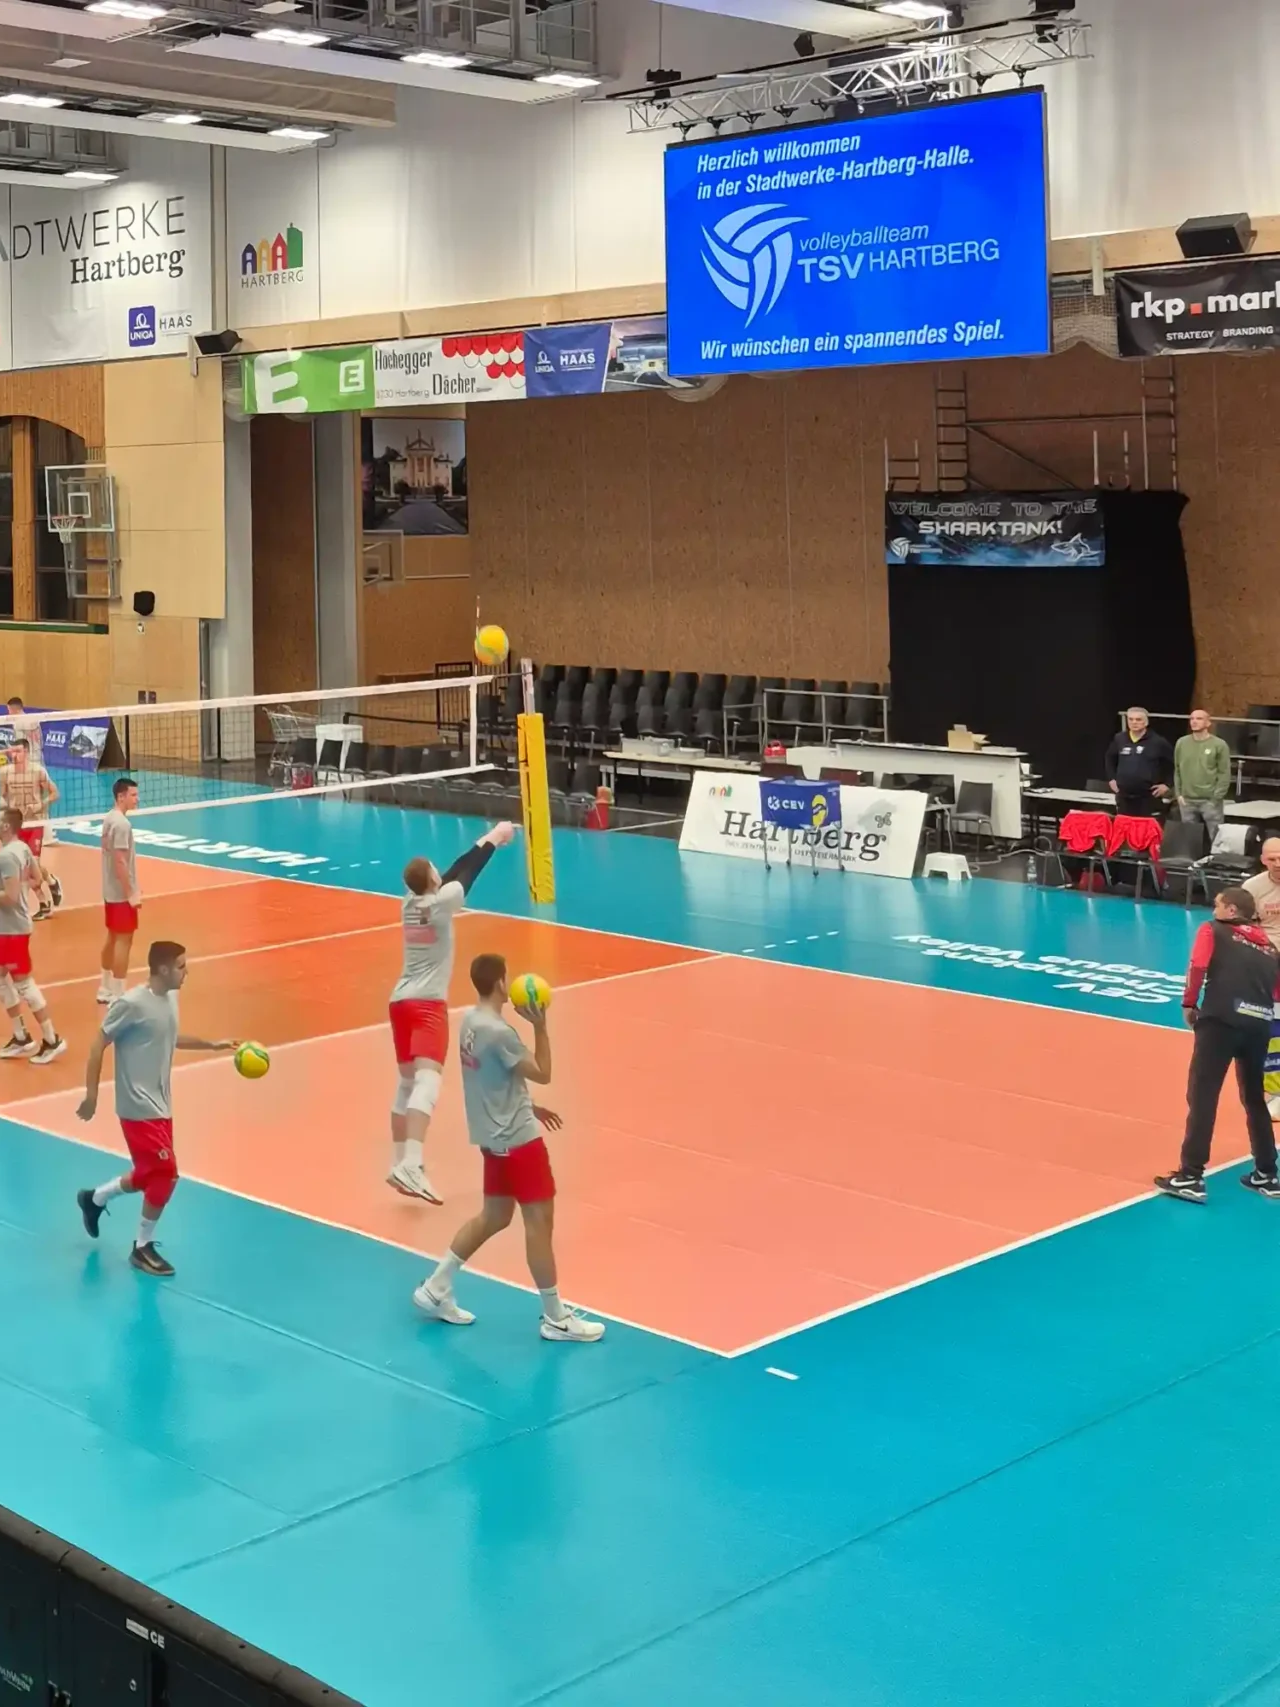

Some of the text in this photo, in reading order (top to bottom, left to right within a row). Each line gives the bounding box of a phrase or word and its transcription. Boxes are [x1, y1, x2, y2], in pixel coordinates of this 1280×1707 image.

[697, 135, 861, 173] Herzlich willkommen
[697, 146, 975, 200] in der Stadtwerke-Hartberg-Halle.
[800, 223, 929, 253] volleyballteam
[70, 249, 186, 284] Hartberg
[797, 238, 1000, 284] TSV HARTBERG
[241, 269, 305, 289] HARTBERG
[1207, 281, 1280, 314] mar
[159, 314, 193, 331] HAAS
[1166, 325, 1273, 341] STRATEGY BRANDING
[130, 331, 154, 342] UNIQA
[701, 319, 1005, 360] Wir wünschen ein spannendes Spiel.
[374, 350, 433, 375] Hochegger
[559, 353, 595, 366] HAAS
[395, 387, 430, 399] Hartberg
[432, 373, 476, 396] Dächer
[889, 499, 1097, 517] WELCOME TO THE
[918, 520, 1064, 537] SHARKTANK!
[782, 800, 805, 811] CEV
[891, 934, 1026, 960] Volley
[1053, 982, 1172, 1004] CEV
[150, 1630, 165, 1649] CE
